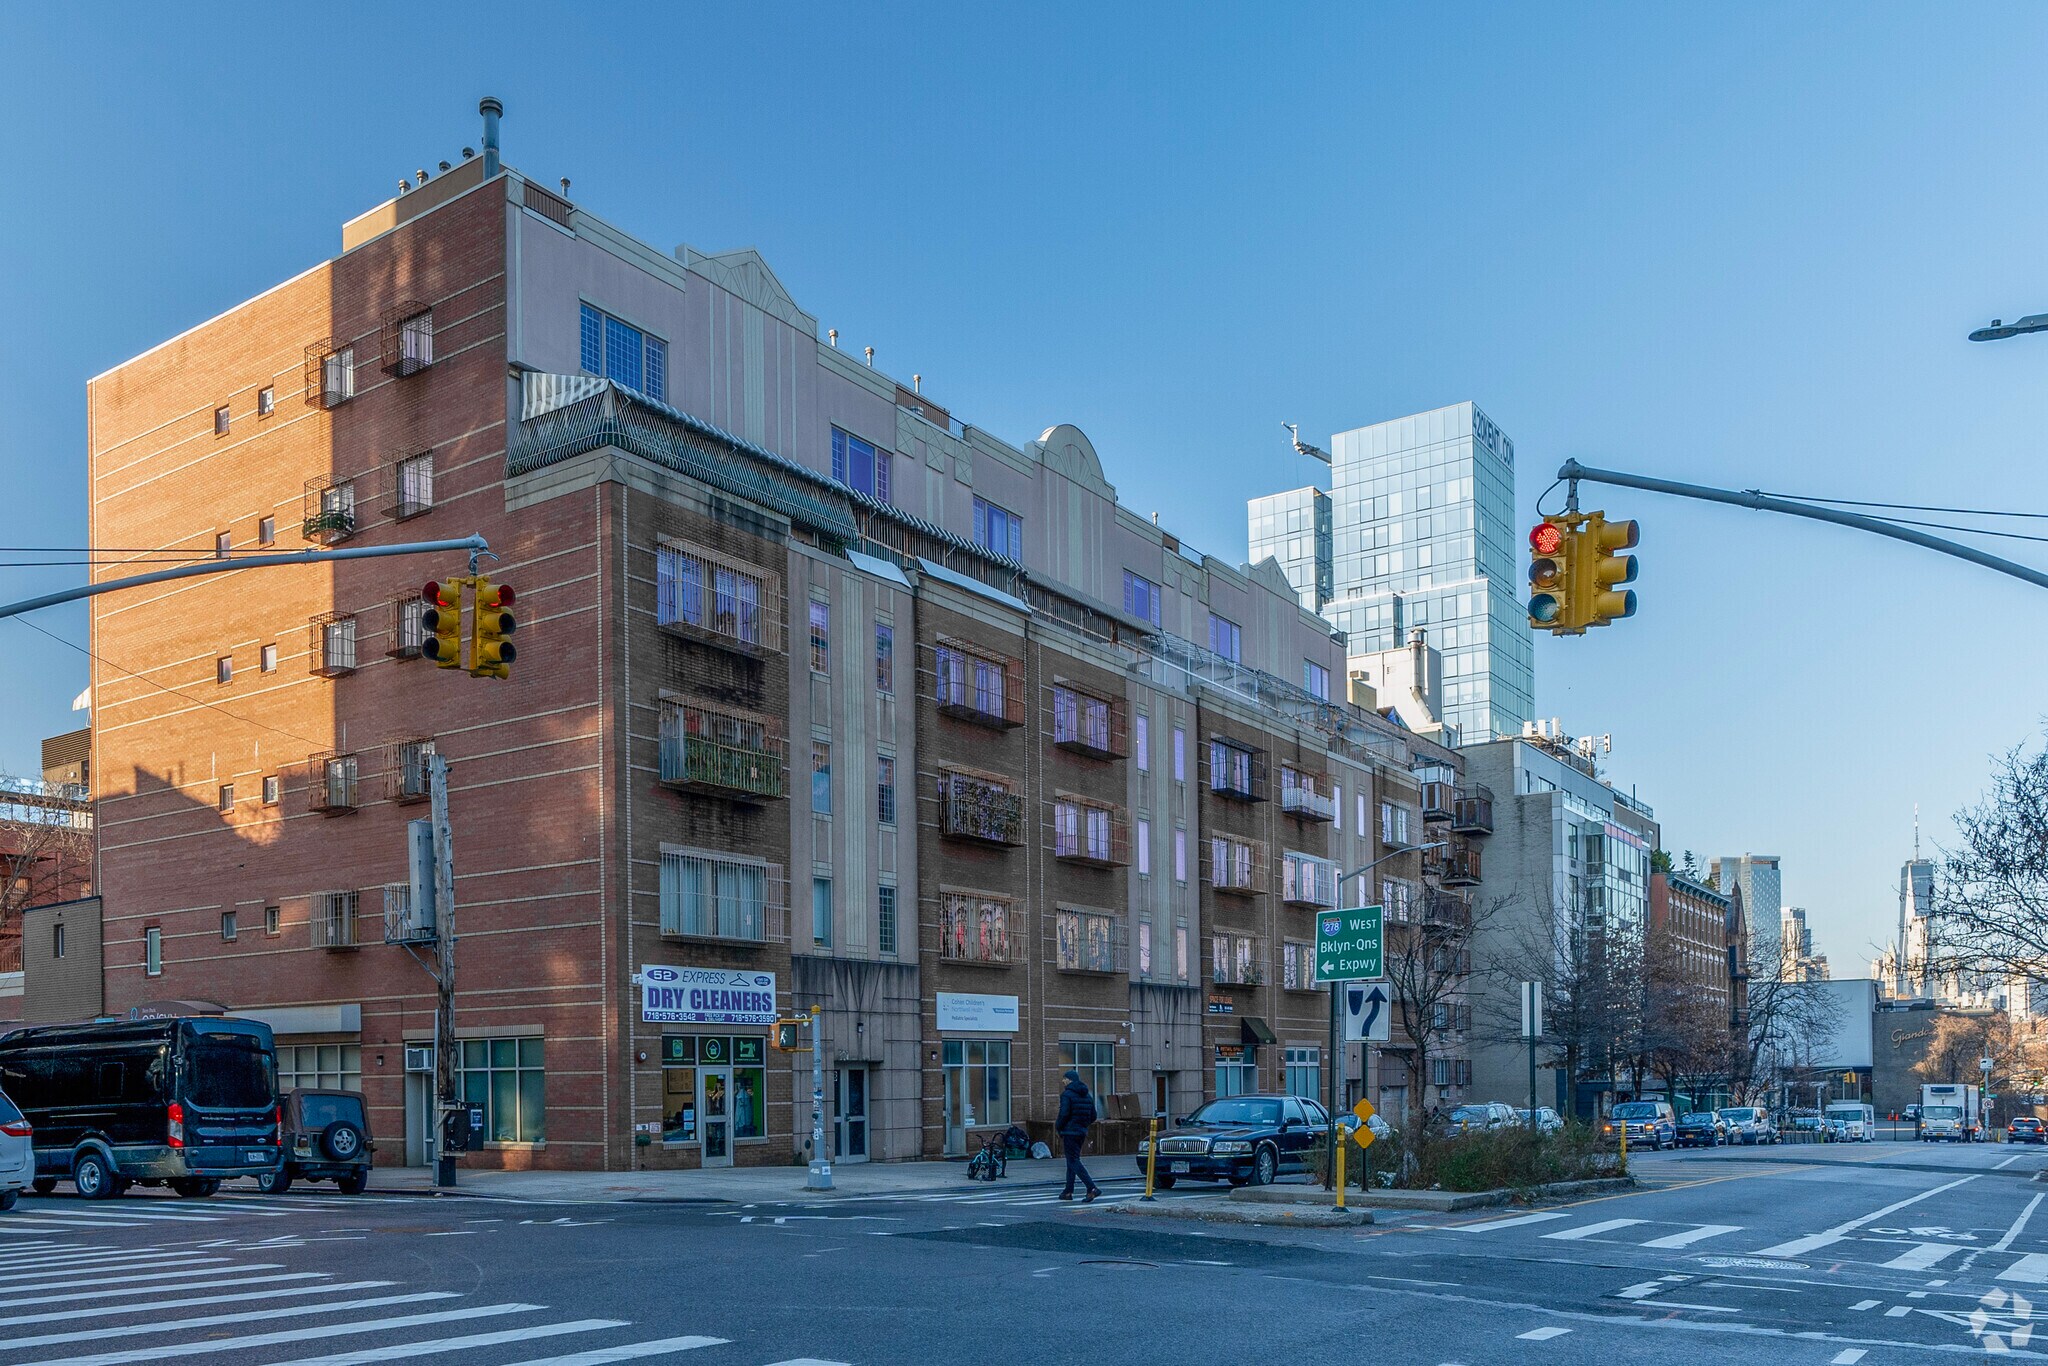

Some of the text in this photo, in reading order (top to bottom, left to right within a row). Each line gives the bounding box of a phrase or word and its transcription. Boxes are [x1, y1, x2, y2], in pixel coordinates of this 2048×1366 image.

[1473, 407, 1514, 469] 420KENT.COM
[1325, 923, 1339, 932] 278
[1350, 919, 1377, 930] WEST
[1320, 938, 1378, 955] Bklyn-Qns
[1340, 959, 1376, 972] Expwy
[653, 971, 726, 985] 52 EXPRESS
[648, 987, 772, 1012] DRY CLEANERS
